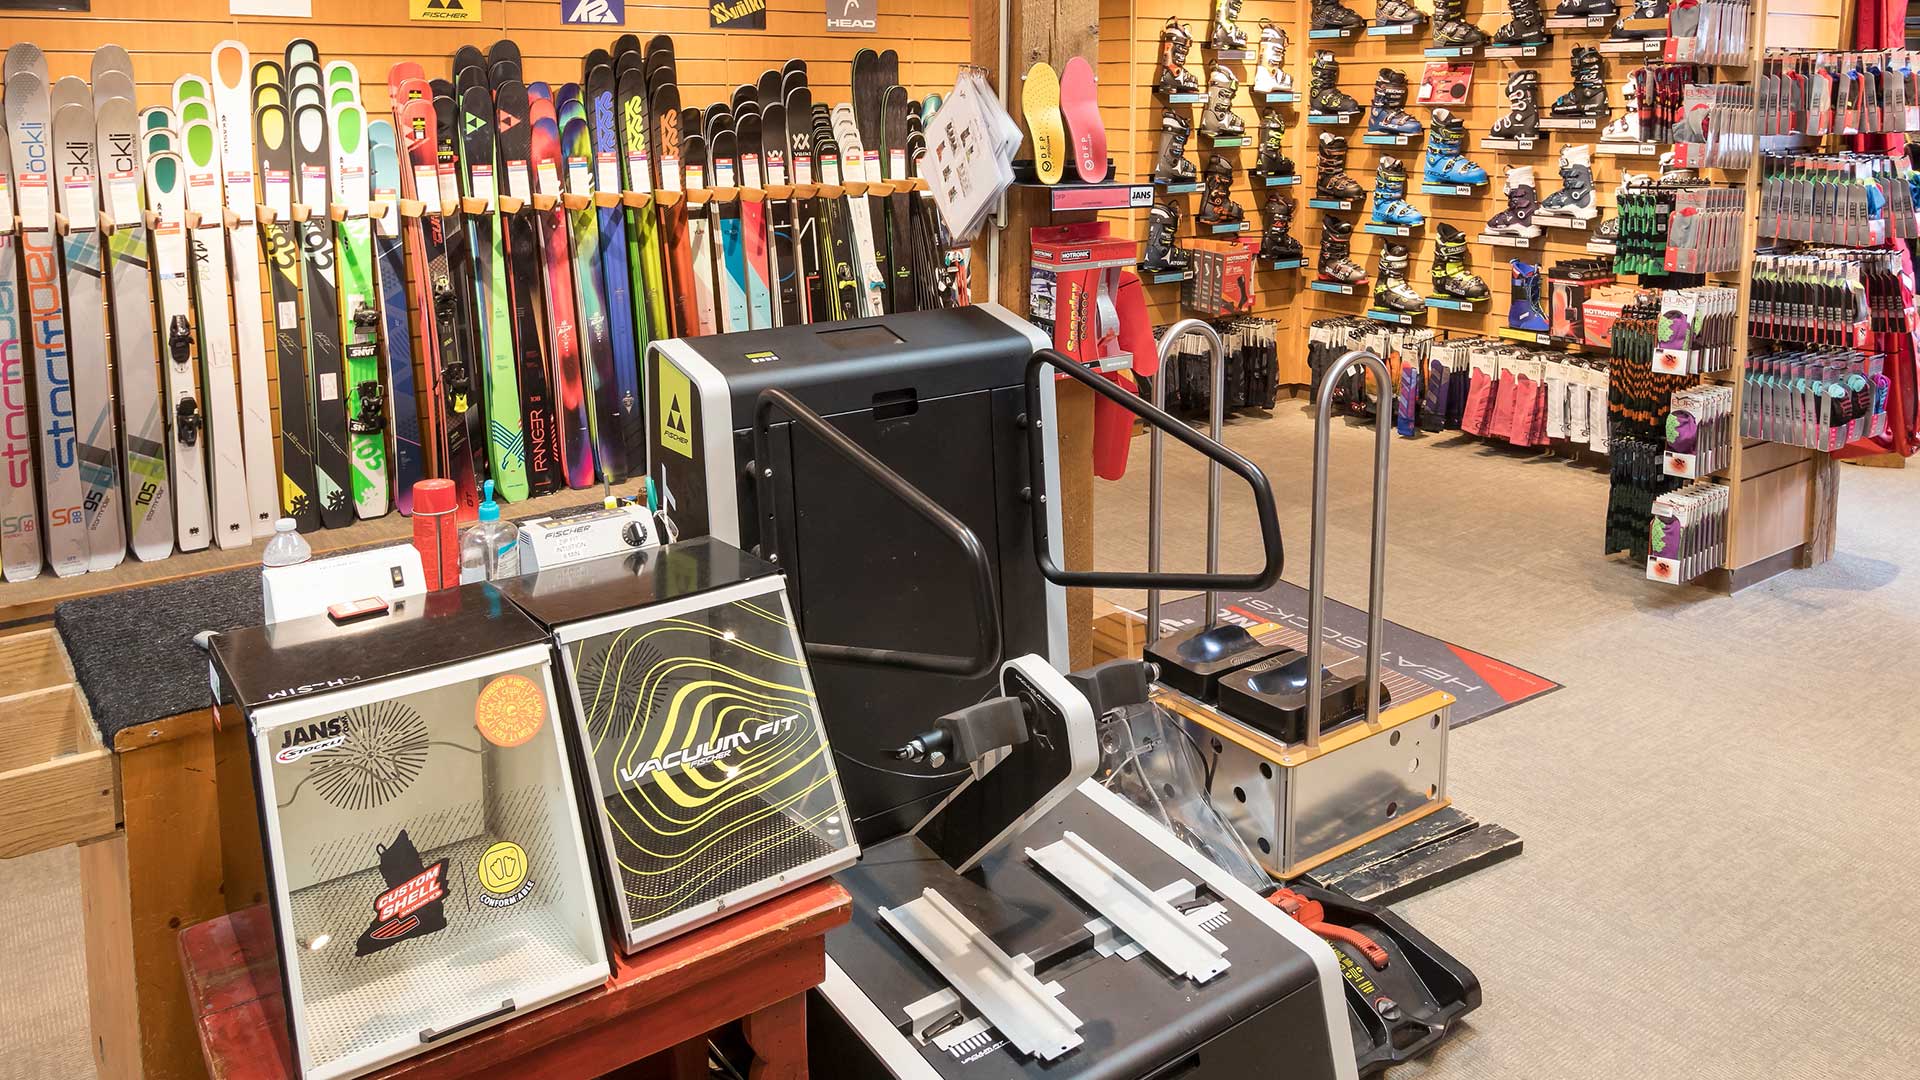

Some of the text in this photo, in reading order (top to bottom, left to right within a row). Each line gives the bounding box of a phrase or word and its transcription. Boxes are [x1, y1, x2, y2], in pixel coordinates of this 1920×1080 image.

[827, 18, 876, 28] HEAD
[20, 122, 47, 173] öckli
[66, 142, 90, 176] ckli
[109, 133, 133, 173] ckli
[1132, 191, 1151, 200] JANS
[1062, 250, 1090, 259] HOTRONIC
[1066, 281, 1082, 352] Snapdry
[1584, 308, 1620, 318] HOTRONIC
[530, 408, 548, 473] RANGER
[664, 430, 689, 445] FISCHER
[84, 490, 103, 512] 95
[136, 482, 157, 506] 105
[545, 524, 592, 540] FISCHER
[281, 718, 341, 748] JANS
[620, 714, 800, 782] VACUUM FIT
[690, 749, 732, 770] FISCHER
[377, 865, 440, 909] CUSTOM
[383, 880, 442, 921] SHELL
